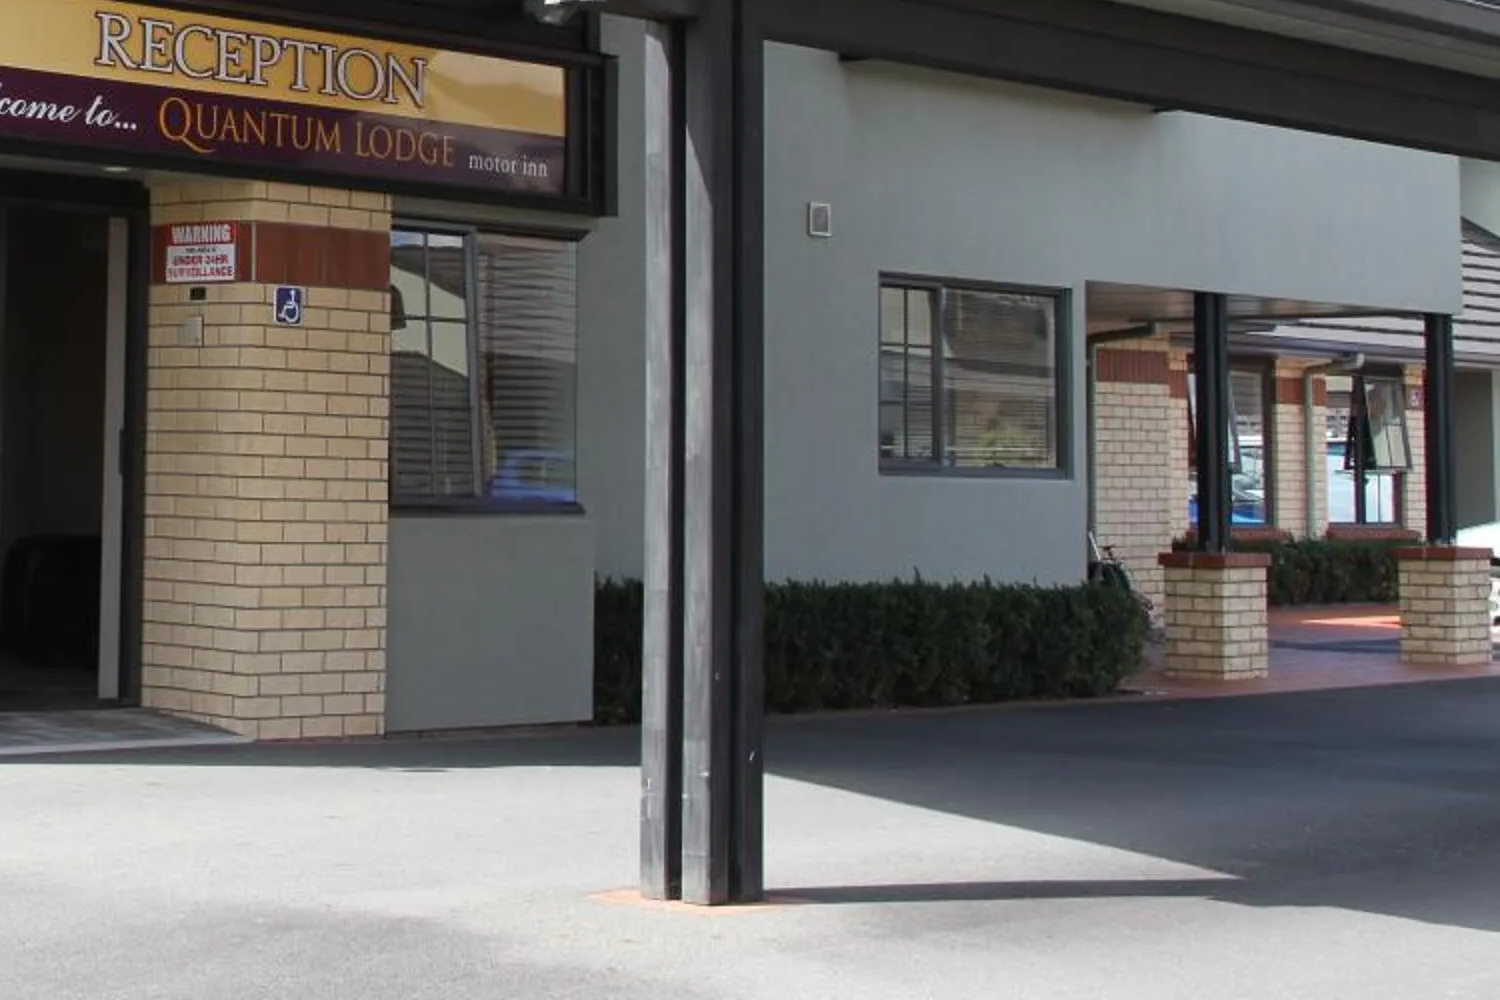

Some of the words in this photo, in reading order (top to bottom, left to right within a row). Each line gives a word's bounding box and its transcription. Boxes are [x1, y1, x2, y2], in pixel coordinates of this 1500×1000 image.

[94, 10, 427, 108] RECEPTION
[85, 95, 137, 131] to...
[158, 96, 342, 154] QUANTUM
[355, 119, 455, 168] LODGE
[468, 152, 520, 176] motor
[522, 154, 549, 178] inn
[172, 224, 231, 244] WARNING
